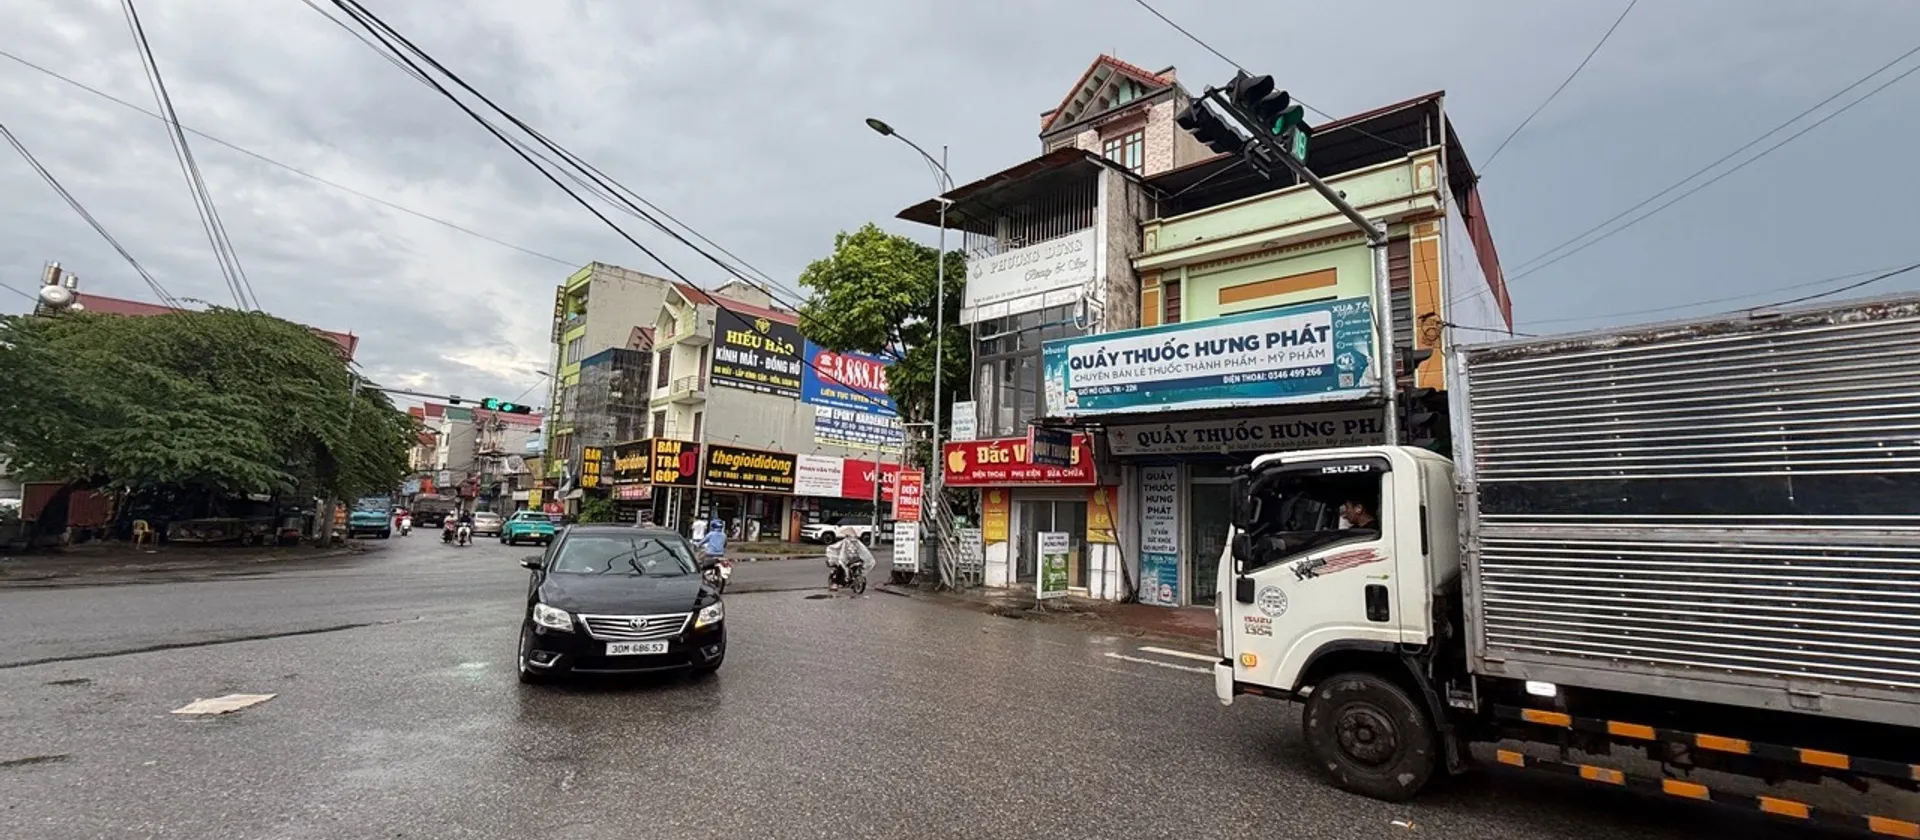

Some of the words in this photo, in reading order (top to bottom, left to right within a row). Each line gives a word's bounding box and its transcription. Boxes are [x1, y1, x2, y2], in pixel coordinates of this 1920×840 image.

[1069, 346, 1120, 371] QUẦY
[1122, 337, 1190, 364] THUỐC
[1195, 335, 1260, 357] HƯNG
[1266, 322, 1331, 349] PHÁT
[715, 346, 738, 363] KÍNH
[740, 350, 759, 367] MẮT
[1074, 370, 1110, 382] CHUYÊN
[1112, 367, 1132, 379] BÁN
[1148, 362, 1182, 375] THUỐC
[1184, 359, 1220, 371] THÀNH
[1224, 354, 1257, 368] PHẨM
[1268, 351, 1285, 364] MỸ
[1289, 348, 1326, 361] PHẨM
[1223, 373, 1240, 384] ĐIỆN
[1241, 372, 1267, 383] THOẠI:
[1268, 371, 1288, 380] 0346
[1290, 369, 1305, 378] 499
[1137, 424, 1188, 448] QUẦY
[1270, 417, 1336, 440] HƯNG
[657, 440, 681, 453] BÁN
[976, 441, 1010, 464] Đắc
[656, 452, 680, 468] TRẢ
[712, 450, 792, 476] thegioididong
[655, 468, 680, 482] GÓP
[971, 470, 986, 479] ĐIỆN
[987, 470, 1006, 479] THOẠI
[1011, 470, 1025, 481] PHỤ
[1026, 468, 1042, 479] KIỆN
[1047, 468, 1061, 477] SỬA
[1062, 468, 1085, 477] CHỮA
[1146, 471, 1173, 481] QUẦY
[1322, 464, 1370, 474] ISUZU
[1143, 481, 1176, 492] THUỐC
[1145, 494, 1173, 504] HƯNG
[1146, 504, 1172, 515] PHÁT
